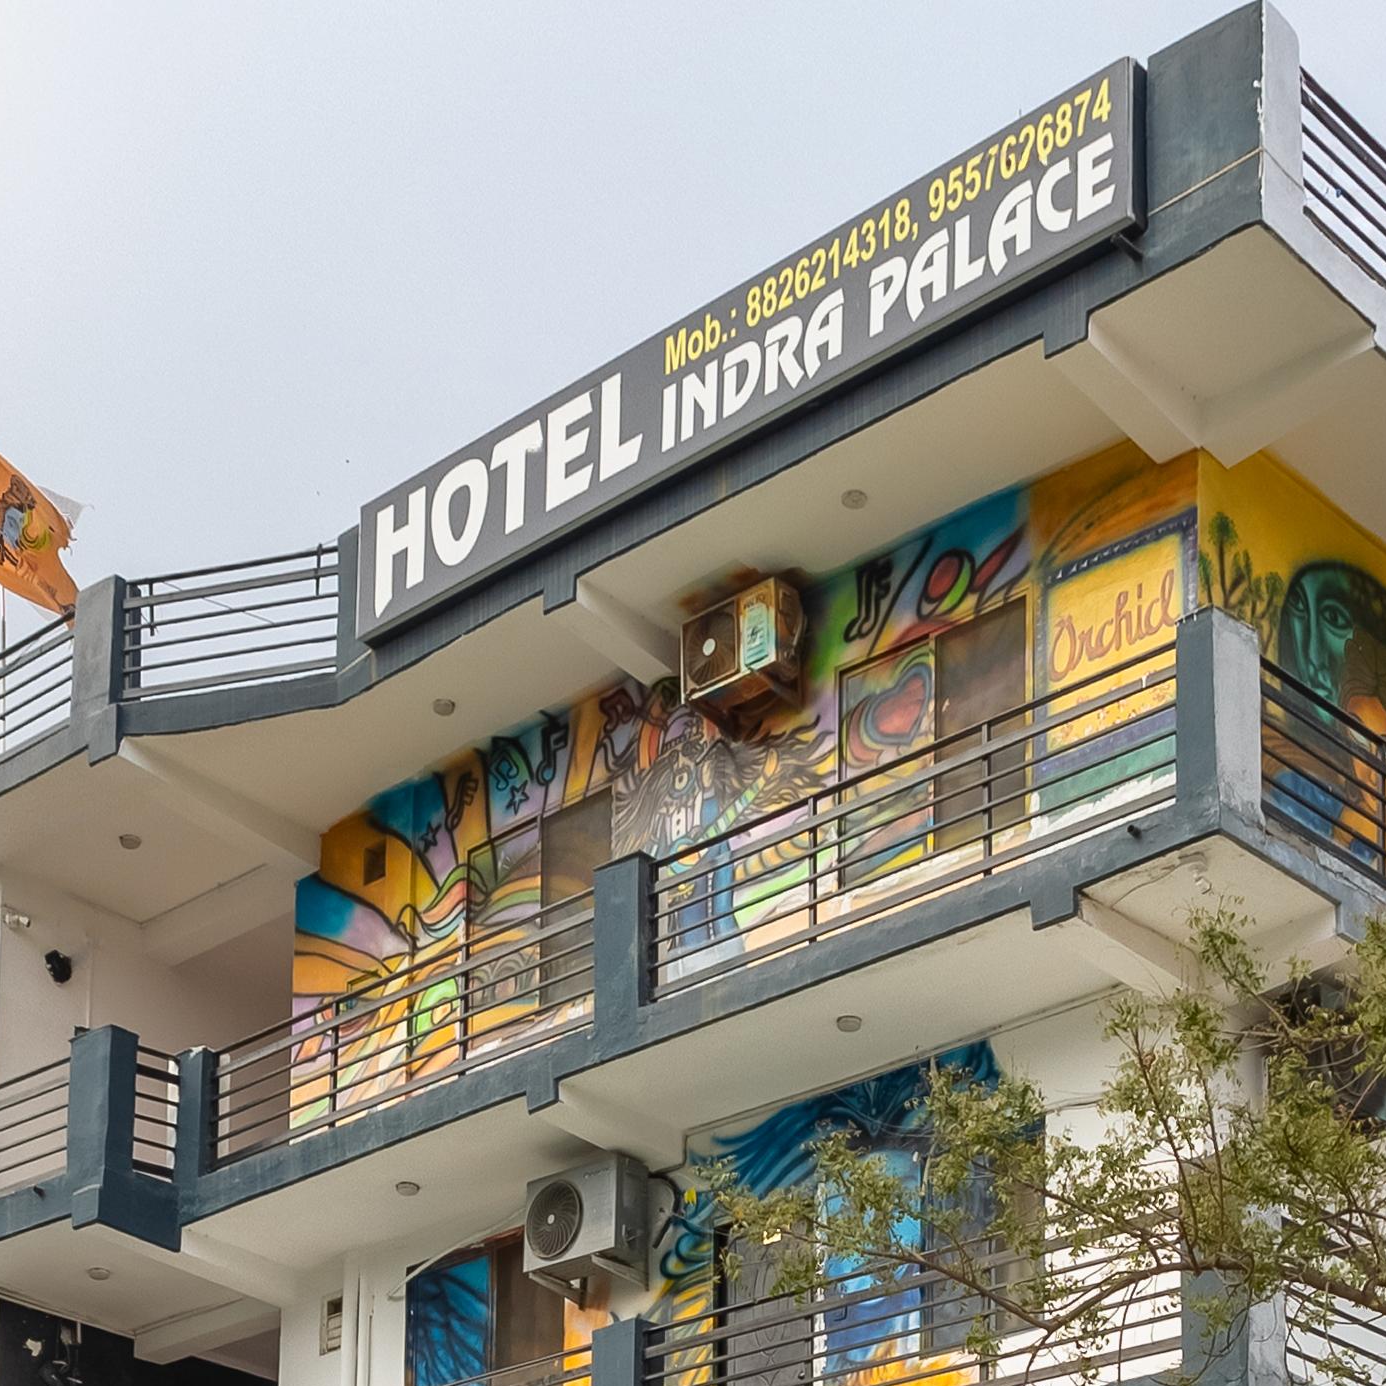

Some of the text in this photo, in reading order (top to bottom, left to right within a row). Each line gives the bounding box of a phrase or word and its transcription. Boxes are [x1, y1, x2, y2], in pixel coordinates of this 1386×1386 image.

[374, 132, 1116, 619] HOTEL INDRA PALACE
[664, 307, 737, 376] Mob.:
[745, 197, 919, 328] 8826214318,
[1049, 568, 1178, 683] Orchid
